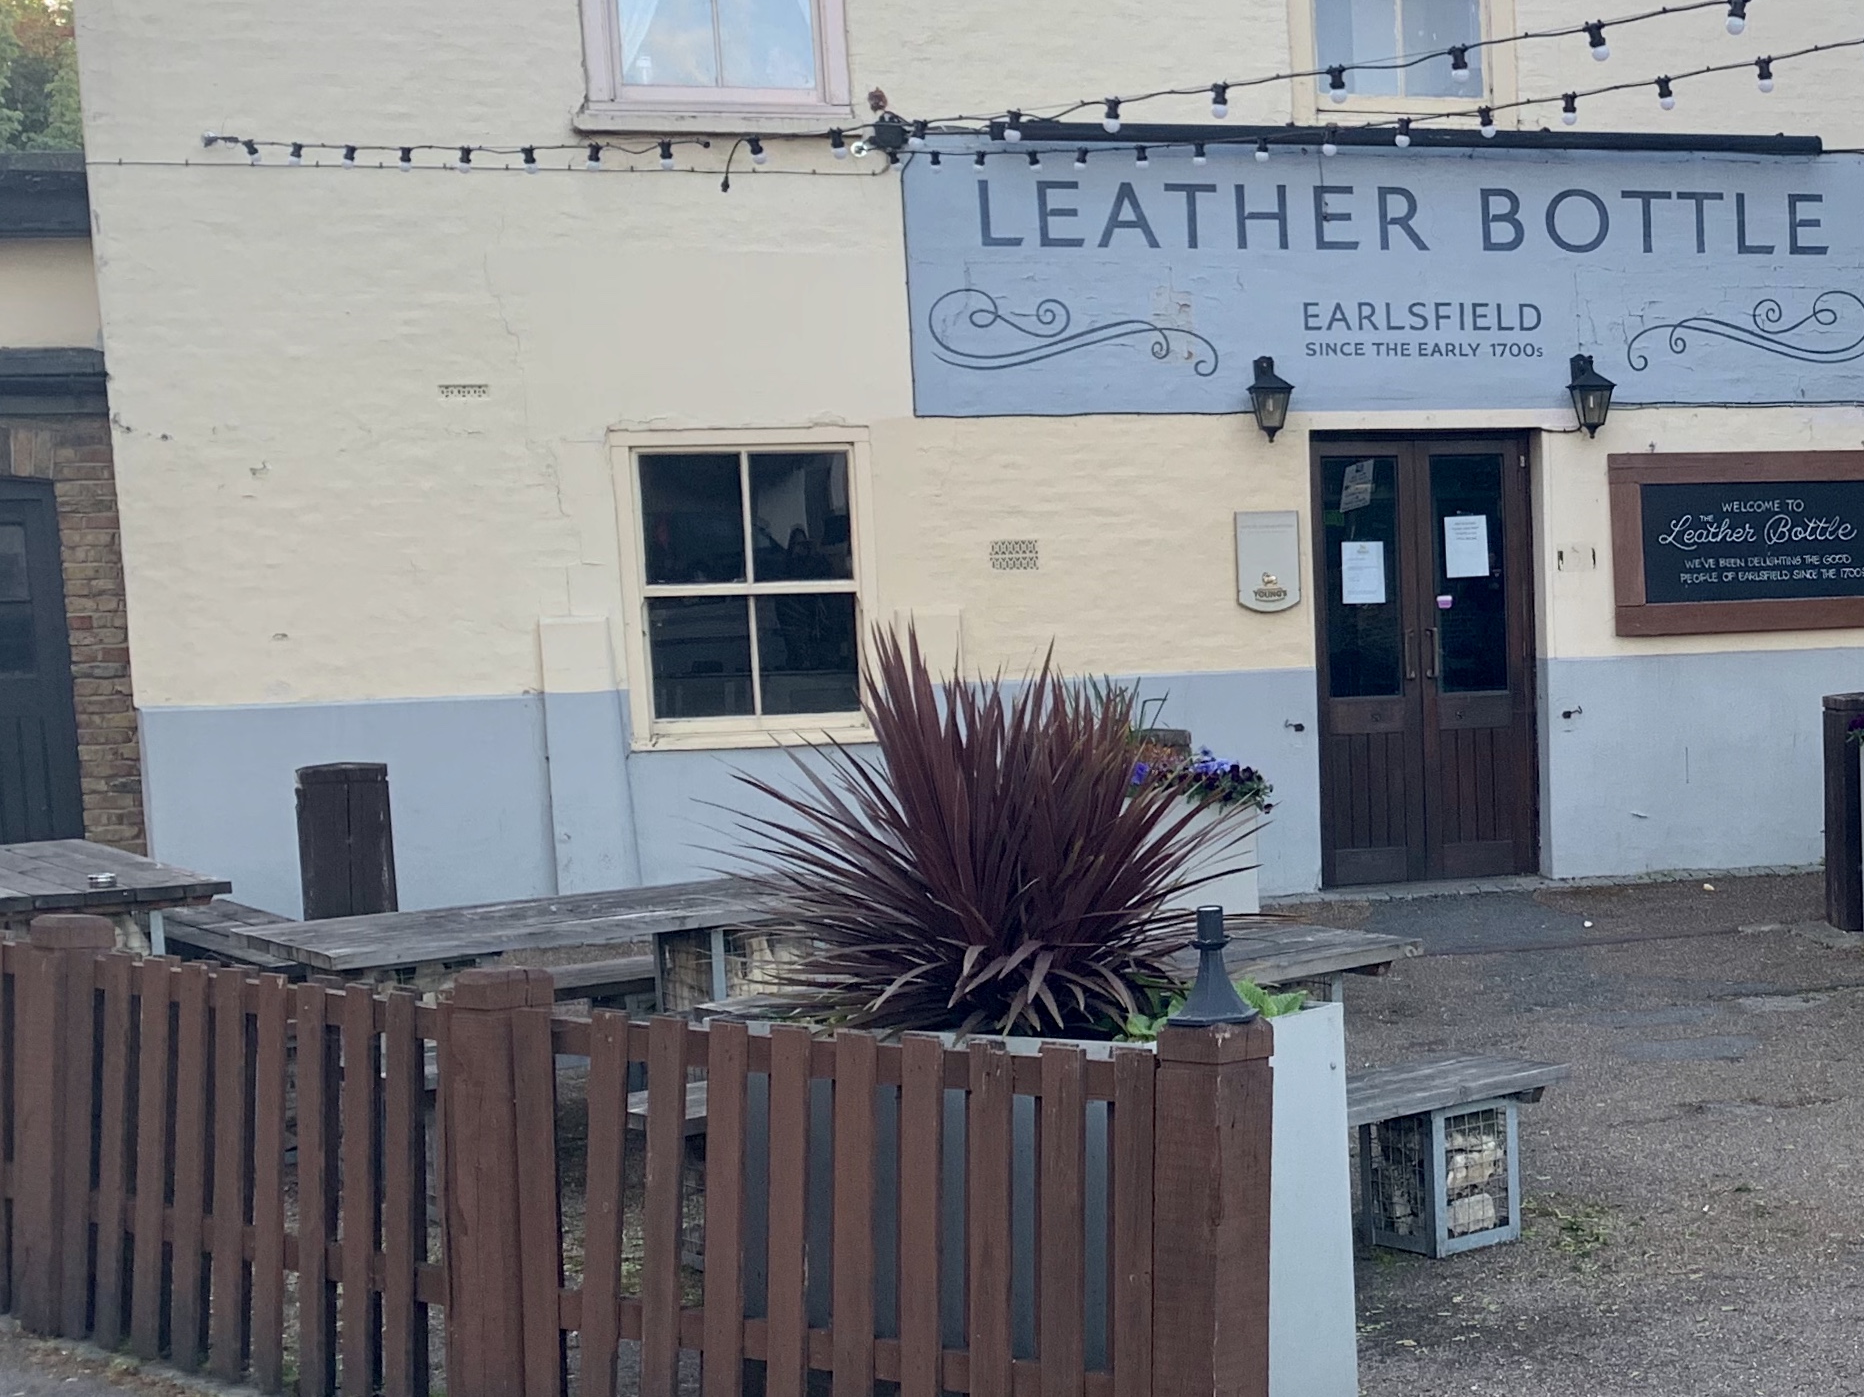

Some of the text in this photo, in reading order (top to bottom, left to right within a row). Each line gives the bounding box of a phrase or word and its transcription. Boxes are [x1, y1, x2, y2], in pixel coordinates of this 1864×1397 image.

[977, 179, 1829, 255] LEATHER BOTTLE
[1303, 301, 1542, 331] EARLSFIELD
[1305, 342, 1543, 358] SINCE THE EARLY 1700s
[1721, 499, 1804, 512] WELCOME TO
[1699, 514, 1714, 522] THE
[1659, 514, 1857, 551] Leather Bottle
[1684, 554, 1851, 569] WE'VE BEEN DELIGHTING THE GOOD
[1680, 572, 1718, 583] PEOPLE
[1722, 572, 1735, 582] OF
[1738, 570, 1790, 581] EARLSFIELD
[1792, 569, 1817, 580] SINCE
[1820, 568, 1837, 579] THE
